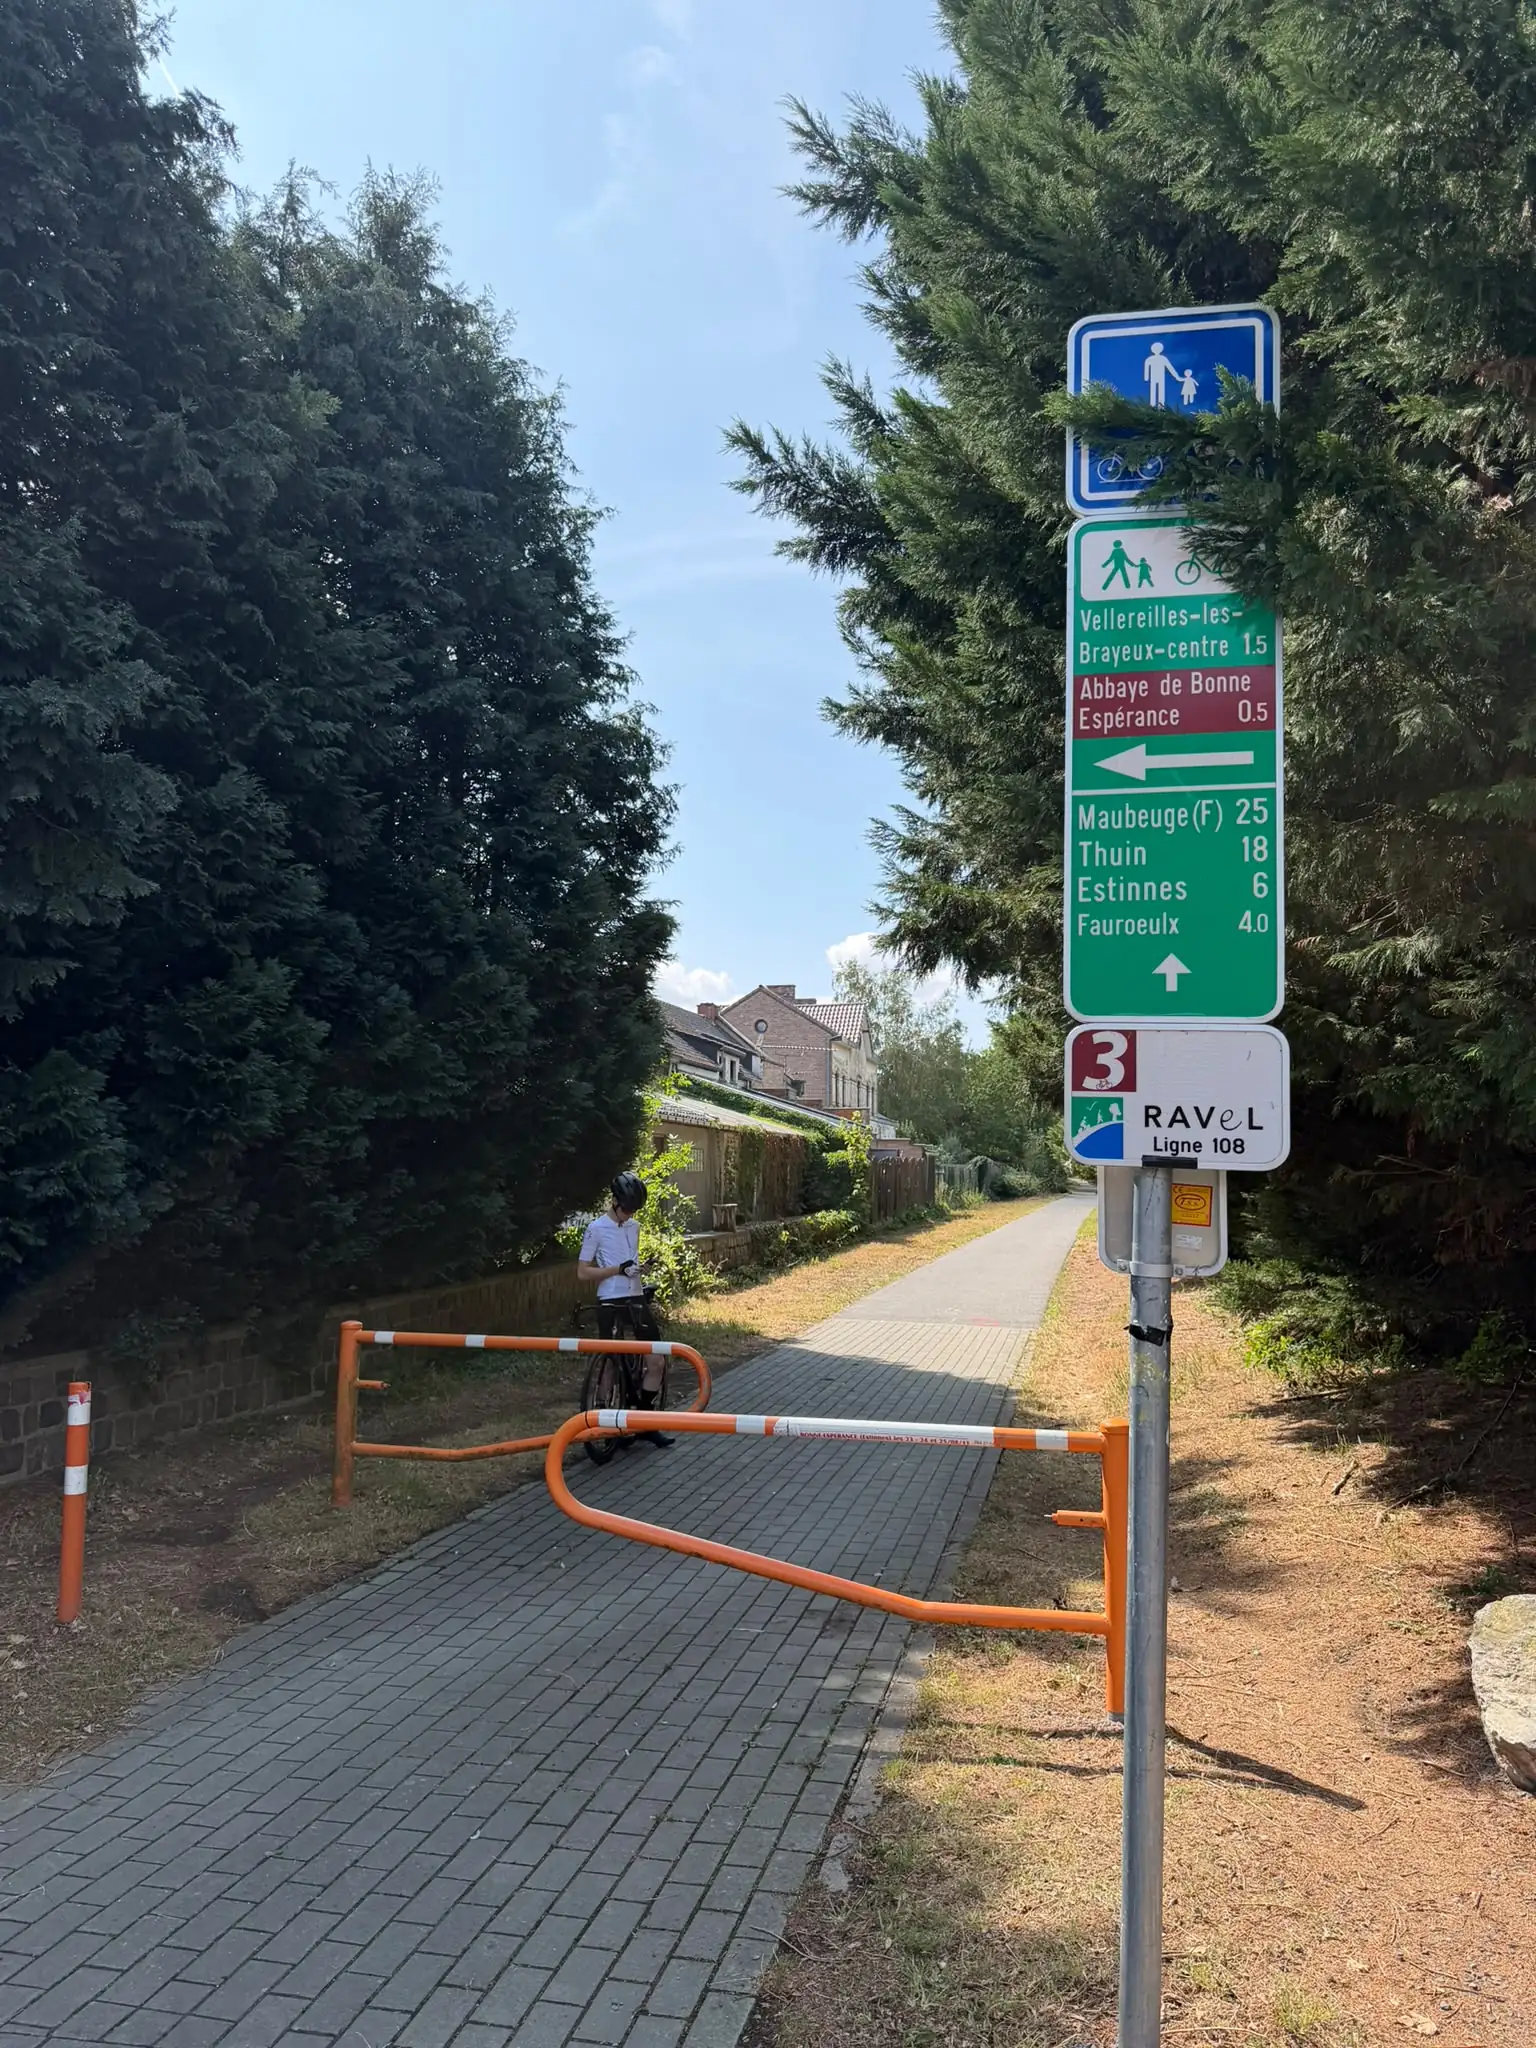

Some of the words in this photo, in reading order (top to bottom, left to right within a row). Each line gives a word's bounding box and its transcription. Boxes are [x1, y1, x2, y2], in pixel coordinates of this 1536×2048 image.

[1080, 602, 1243, 631] Vellereilles-les-
[1080, 635, 1229, 667] Brayeux-centre
[1243, 632, 1267, 655] 1.5
[1080, 676, 1149, 702] Abbaye
[1160, 673, 1182, 696] de
[1191, 671, 1251, 694] Bonne
[1079, 706, 1180, 734] Espérance
[1238, 699, 1268, 722] 0.5
[1236, 797, 1268, 825] 25
[1079, 840, 1147, 867] Thuin
[1242, 835, 1268, 862] 18
[1078, 875, 1188, 902] Estinnes
[1253, 872, 1269, 899] 6
[1077, 912, 1180, 937] Fauroeulx
[1238, 910, 1269, 933] 4.0
[1082, 1031, 1128, 1090] 3
[1144, 1105, 1264, 1131] RAVeL
[1153, 1136, 1202, 1156] Ligne
[1213, 1138, 1245, 1154] 108
